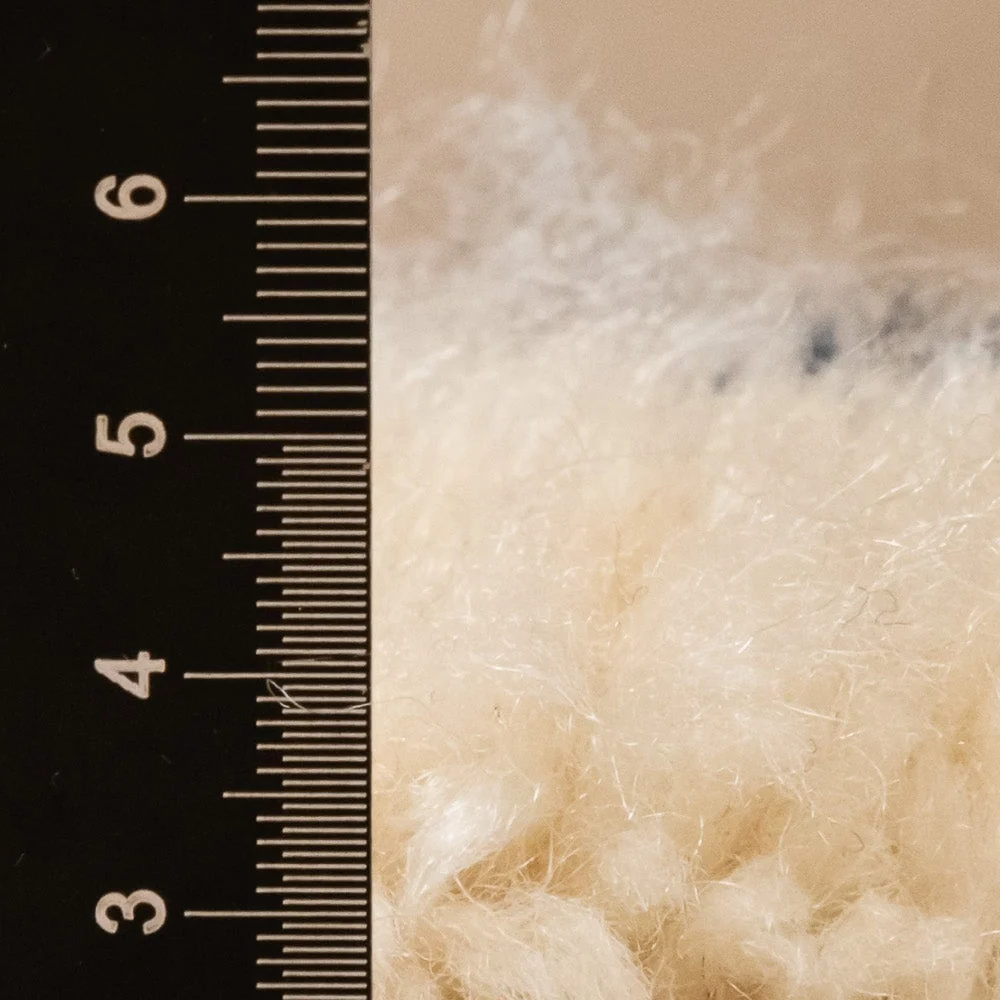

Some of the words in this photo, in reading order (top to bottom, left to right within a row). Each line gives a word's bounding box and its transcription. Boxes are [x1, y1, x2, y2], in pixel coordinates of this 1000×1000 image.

[94, 173, 167, 220] 6
[95, 411, 167, 458] 5
[94, 650, 166, 700] 4
[94, 889, 167, 935] 3
